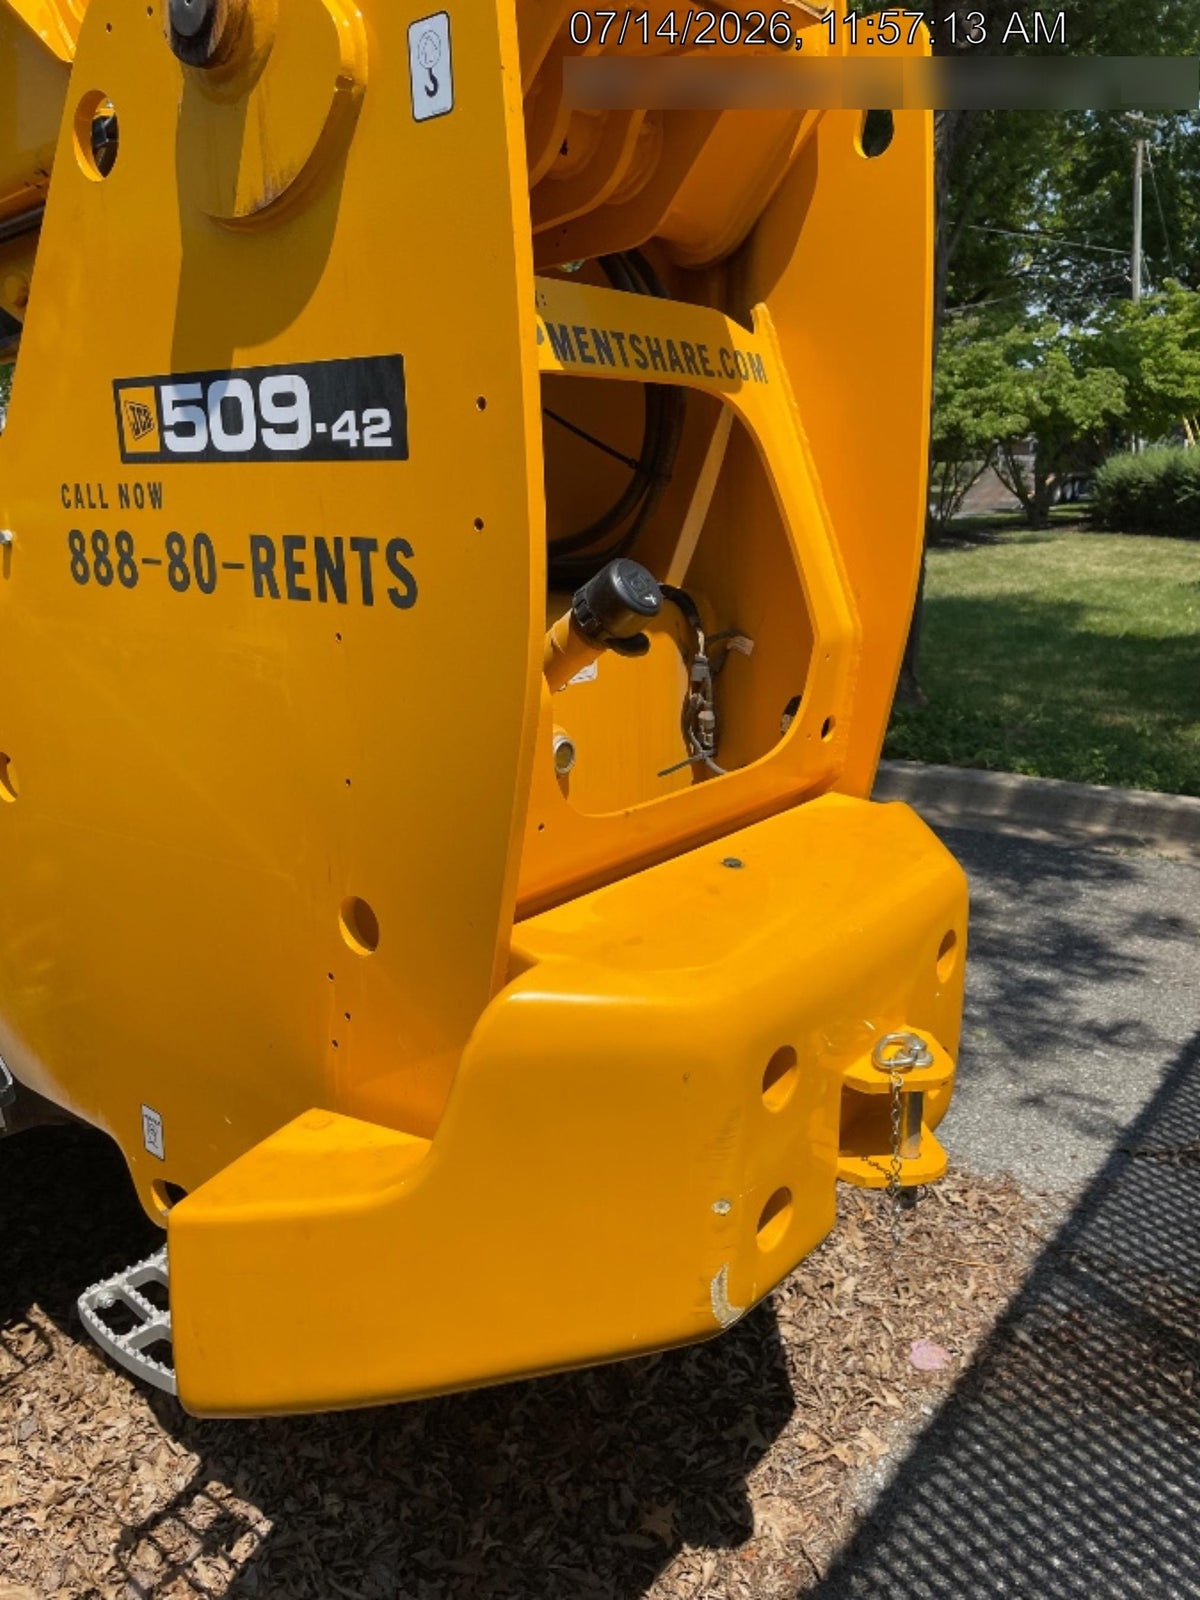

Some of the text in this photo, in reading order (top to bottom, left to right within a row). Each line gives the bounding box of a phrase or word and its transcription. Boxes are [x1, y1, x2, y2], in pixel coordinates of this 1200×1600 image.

[160, 374, 393, 452] 509-42
[61, 482, 163, 509] CALL NOW
[68, 529, 418, 610] 888-80-RENTS
